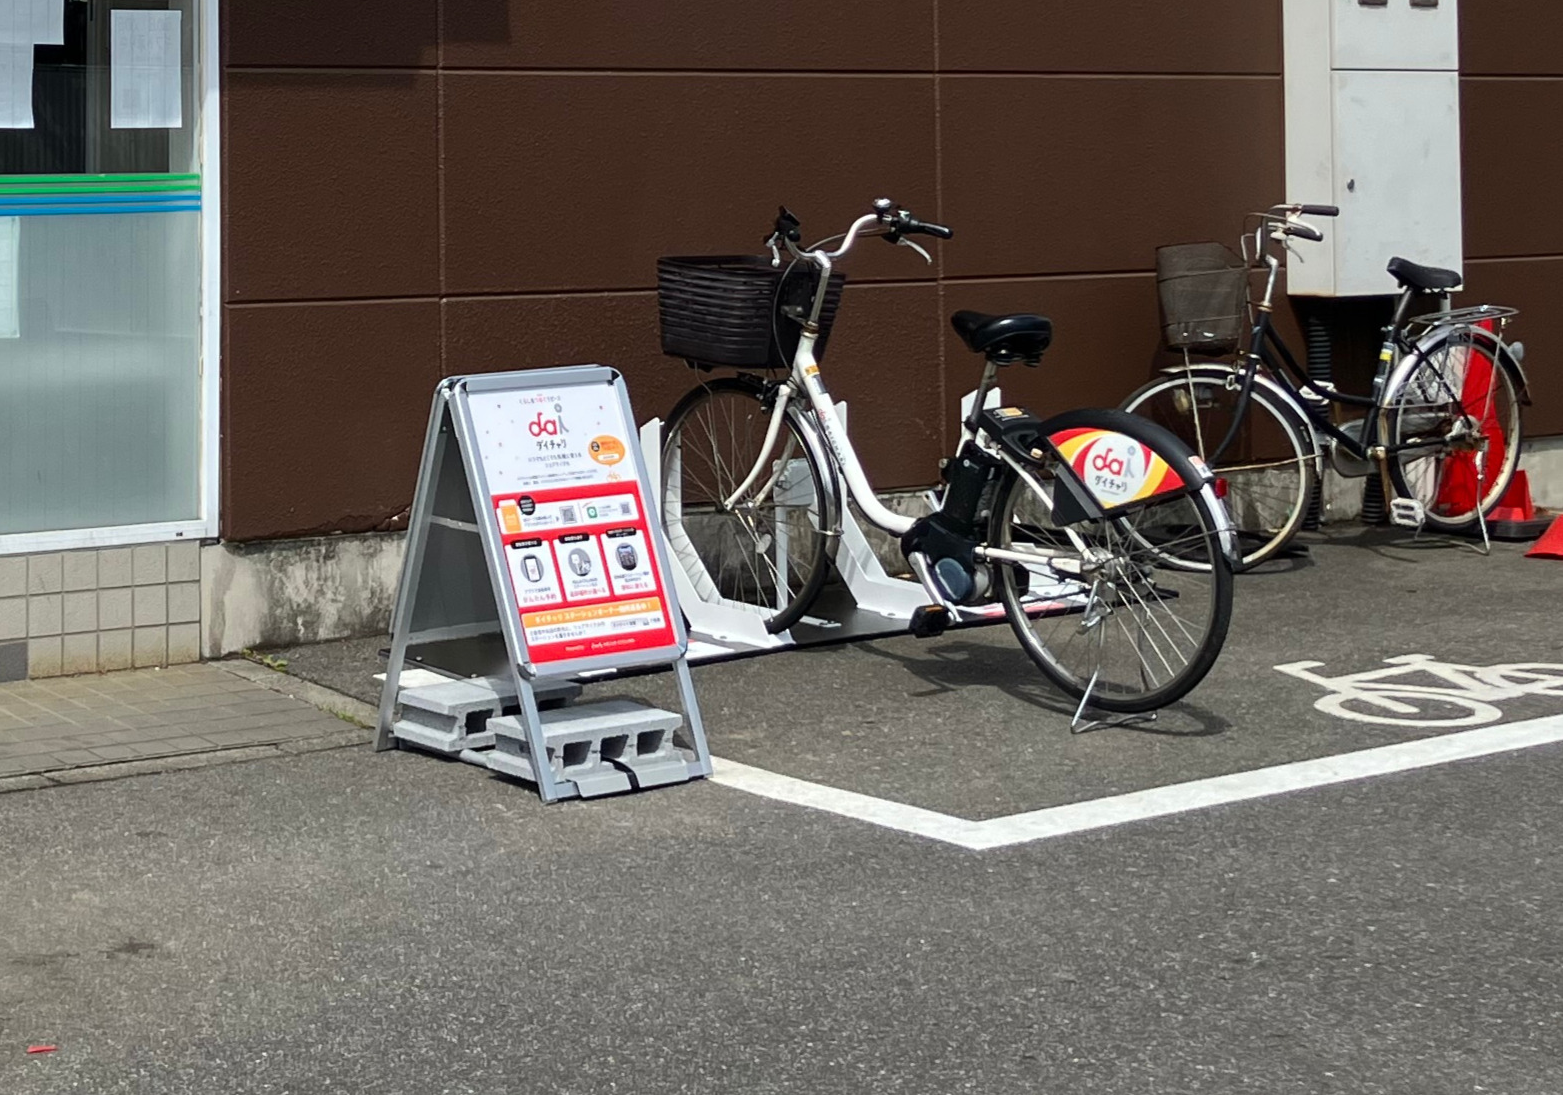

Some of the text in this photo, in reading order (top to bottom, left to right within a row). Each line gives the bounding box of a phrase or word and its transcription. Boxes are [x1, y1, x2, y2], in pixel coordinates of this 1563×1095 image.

[536, 439, 567, 451] ダイチャリ
[1094, 475, 1128, 492] ダイチャリ
